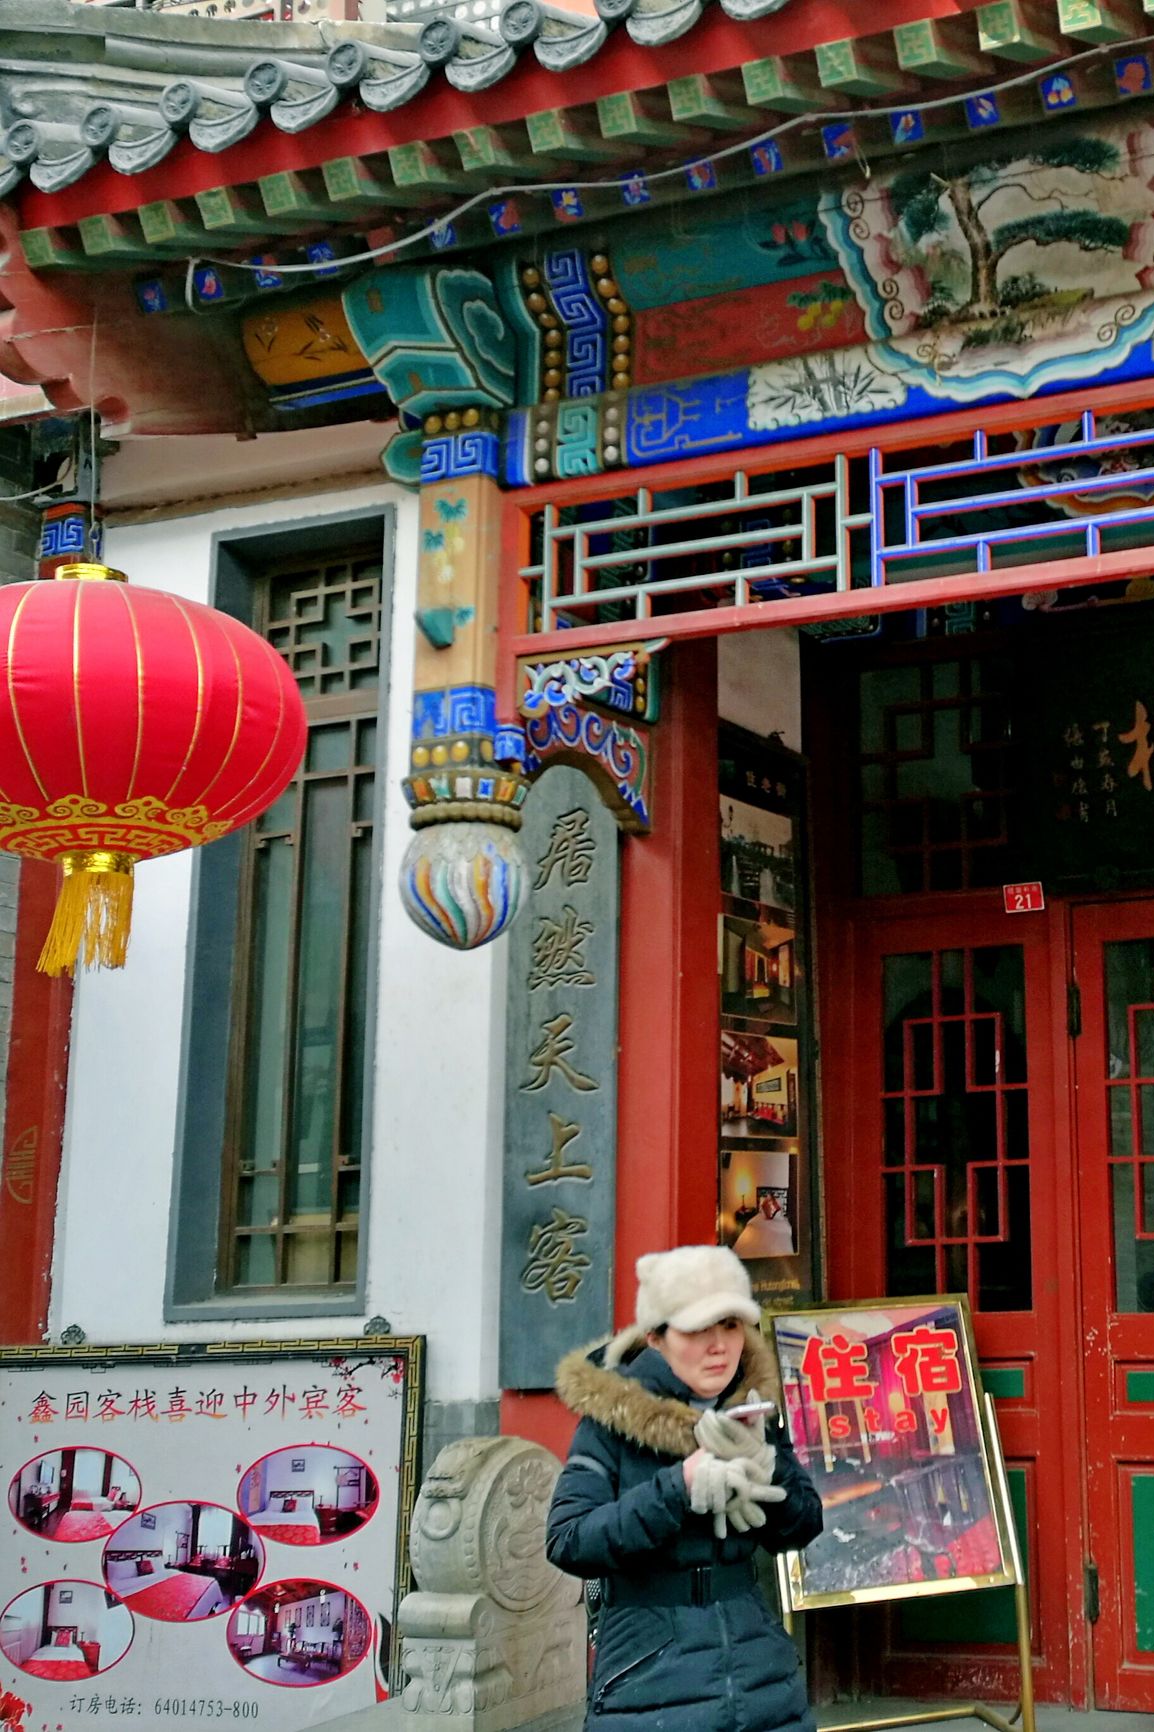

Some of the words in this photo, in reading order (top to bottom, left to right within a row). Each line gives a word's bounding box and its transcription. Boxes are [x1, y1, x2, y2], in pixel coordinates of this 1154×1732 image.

[1014, 893, 1032, 910] 21
[518, 806, 601, 1308] 居然天上客
[801, 1327, 962, 1403] 住宿
[28, 1383, 367, 1425] 鑫园客栈喜迎中外宾客
[828, 1406, 948, 1438] stay
